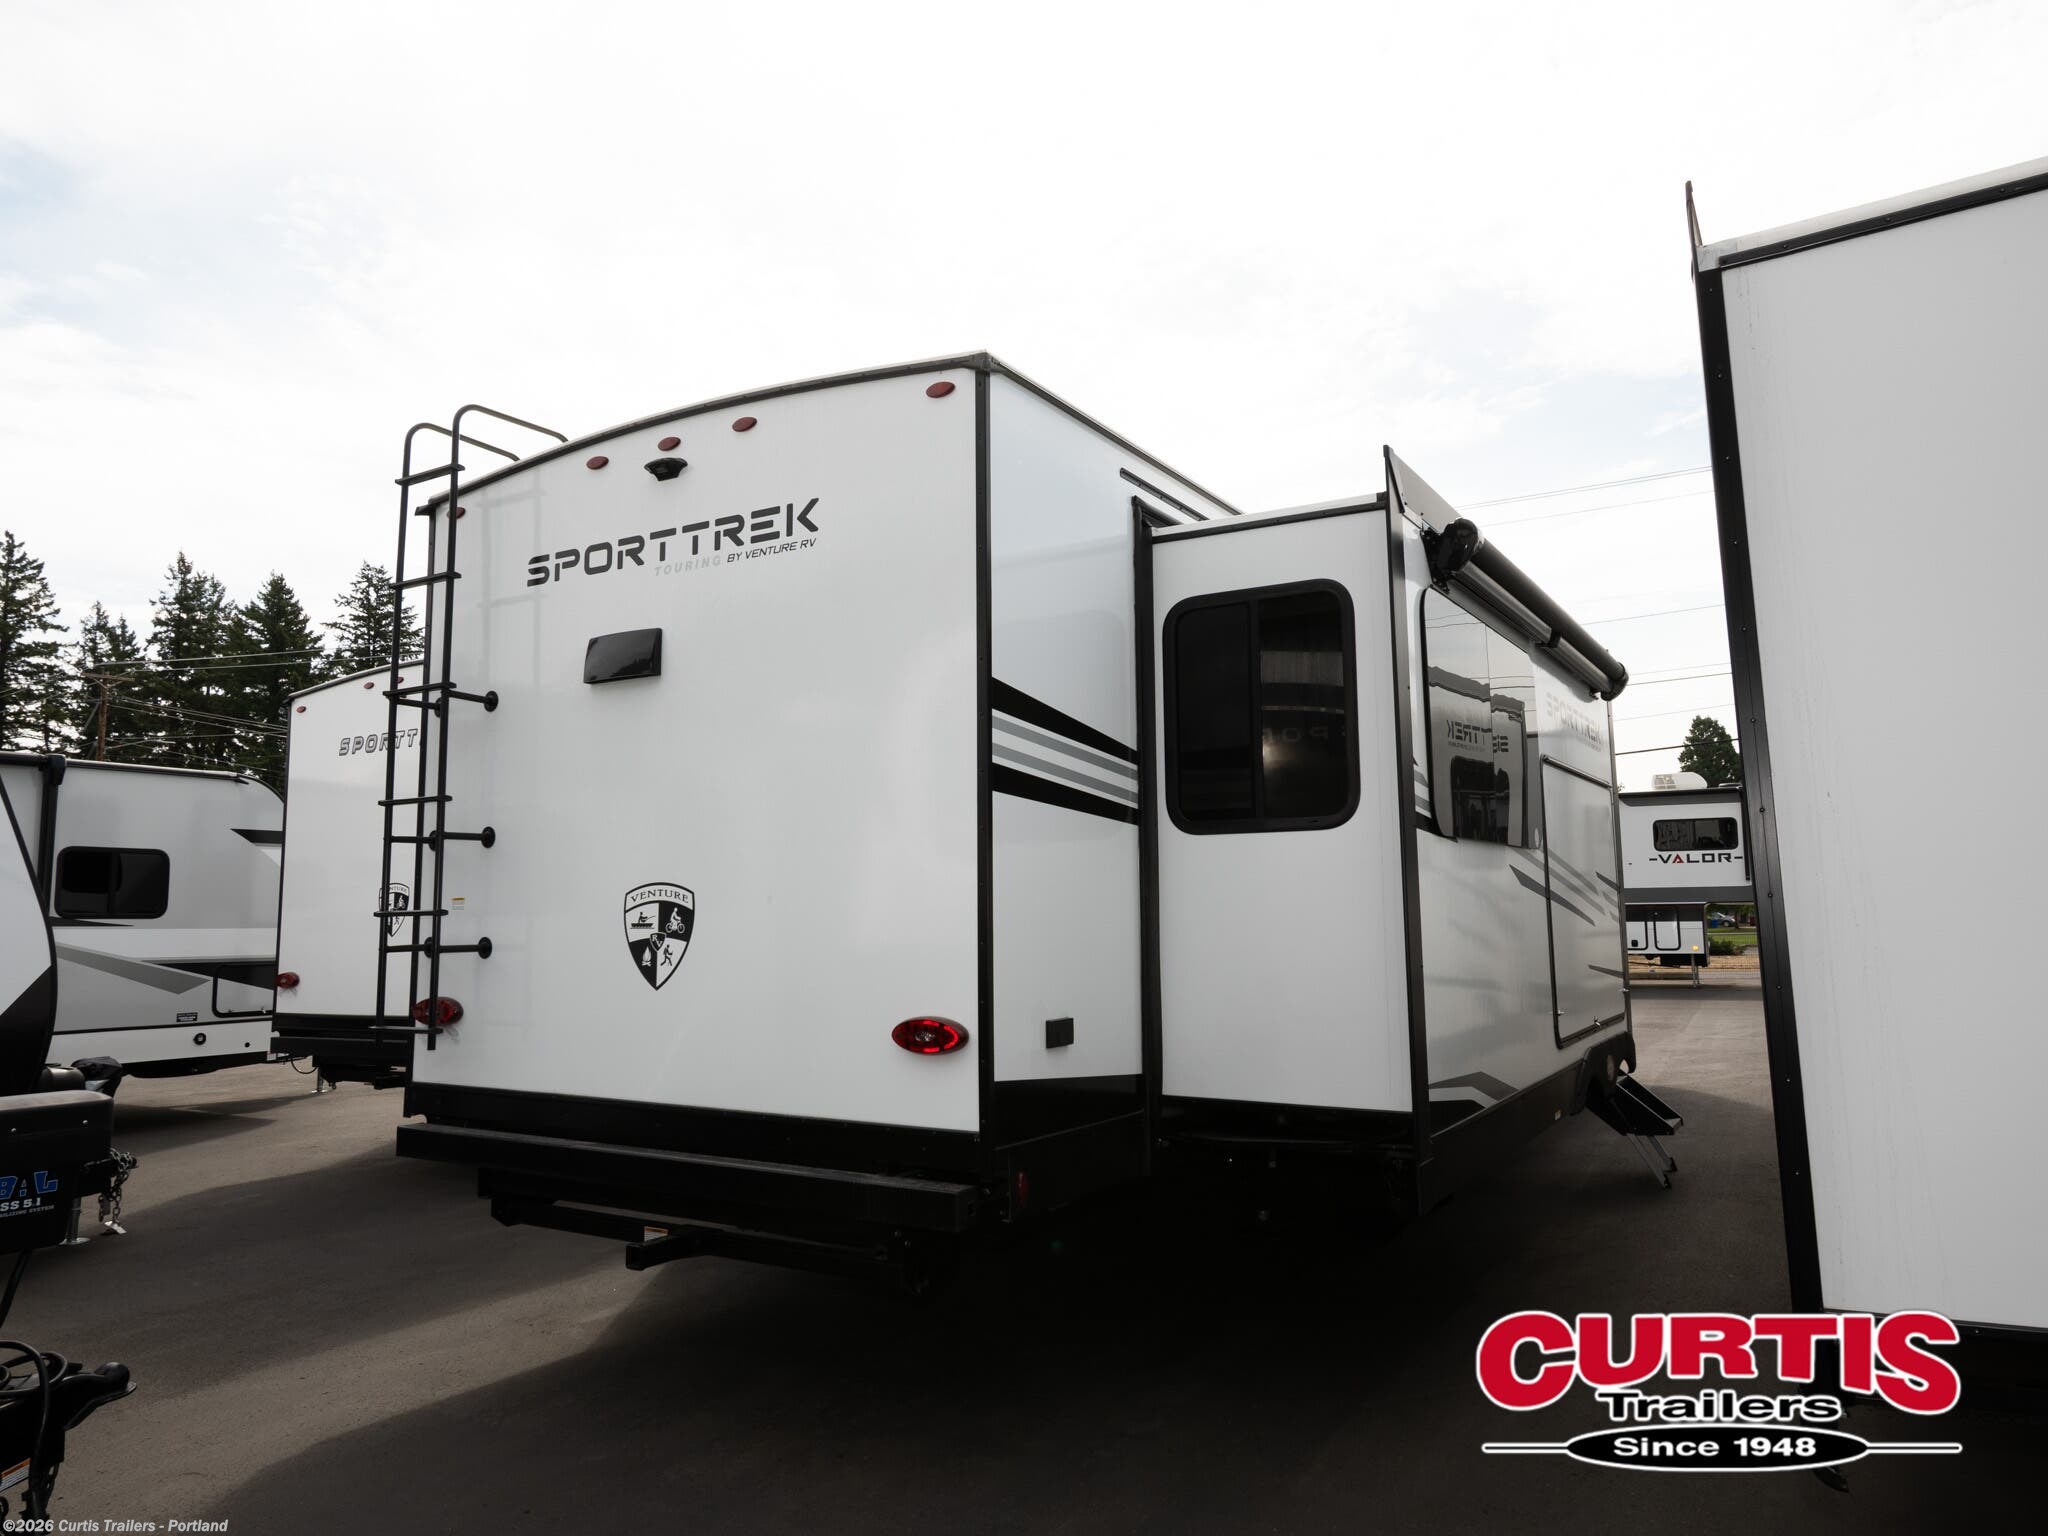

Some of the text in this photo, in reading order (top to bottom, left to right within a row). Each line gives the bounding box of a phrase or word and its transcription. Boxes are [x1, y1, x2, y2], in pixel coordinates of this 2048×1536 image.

[527, 498, 819, 586] SPORTTREK
[654, 538, 817, 576] TOURING BY VENTURE RV
[338, 728, 419, 756] SPORTT
[630, 889, 689, 903] VENTURE
